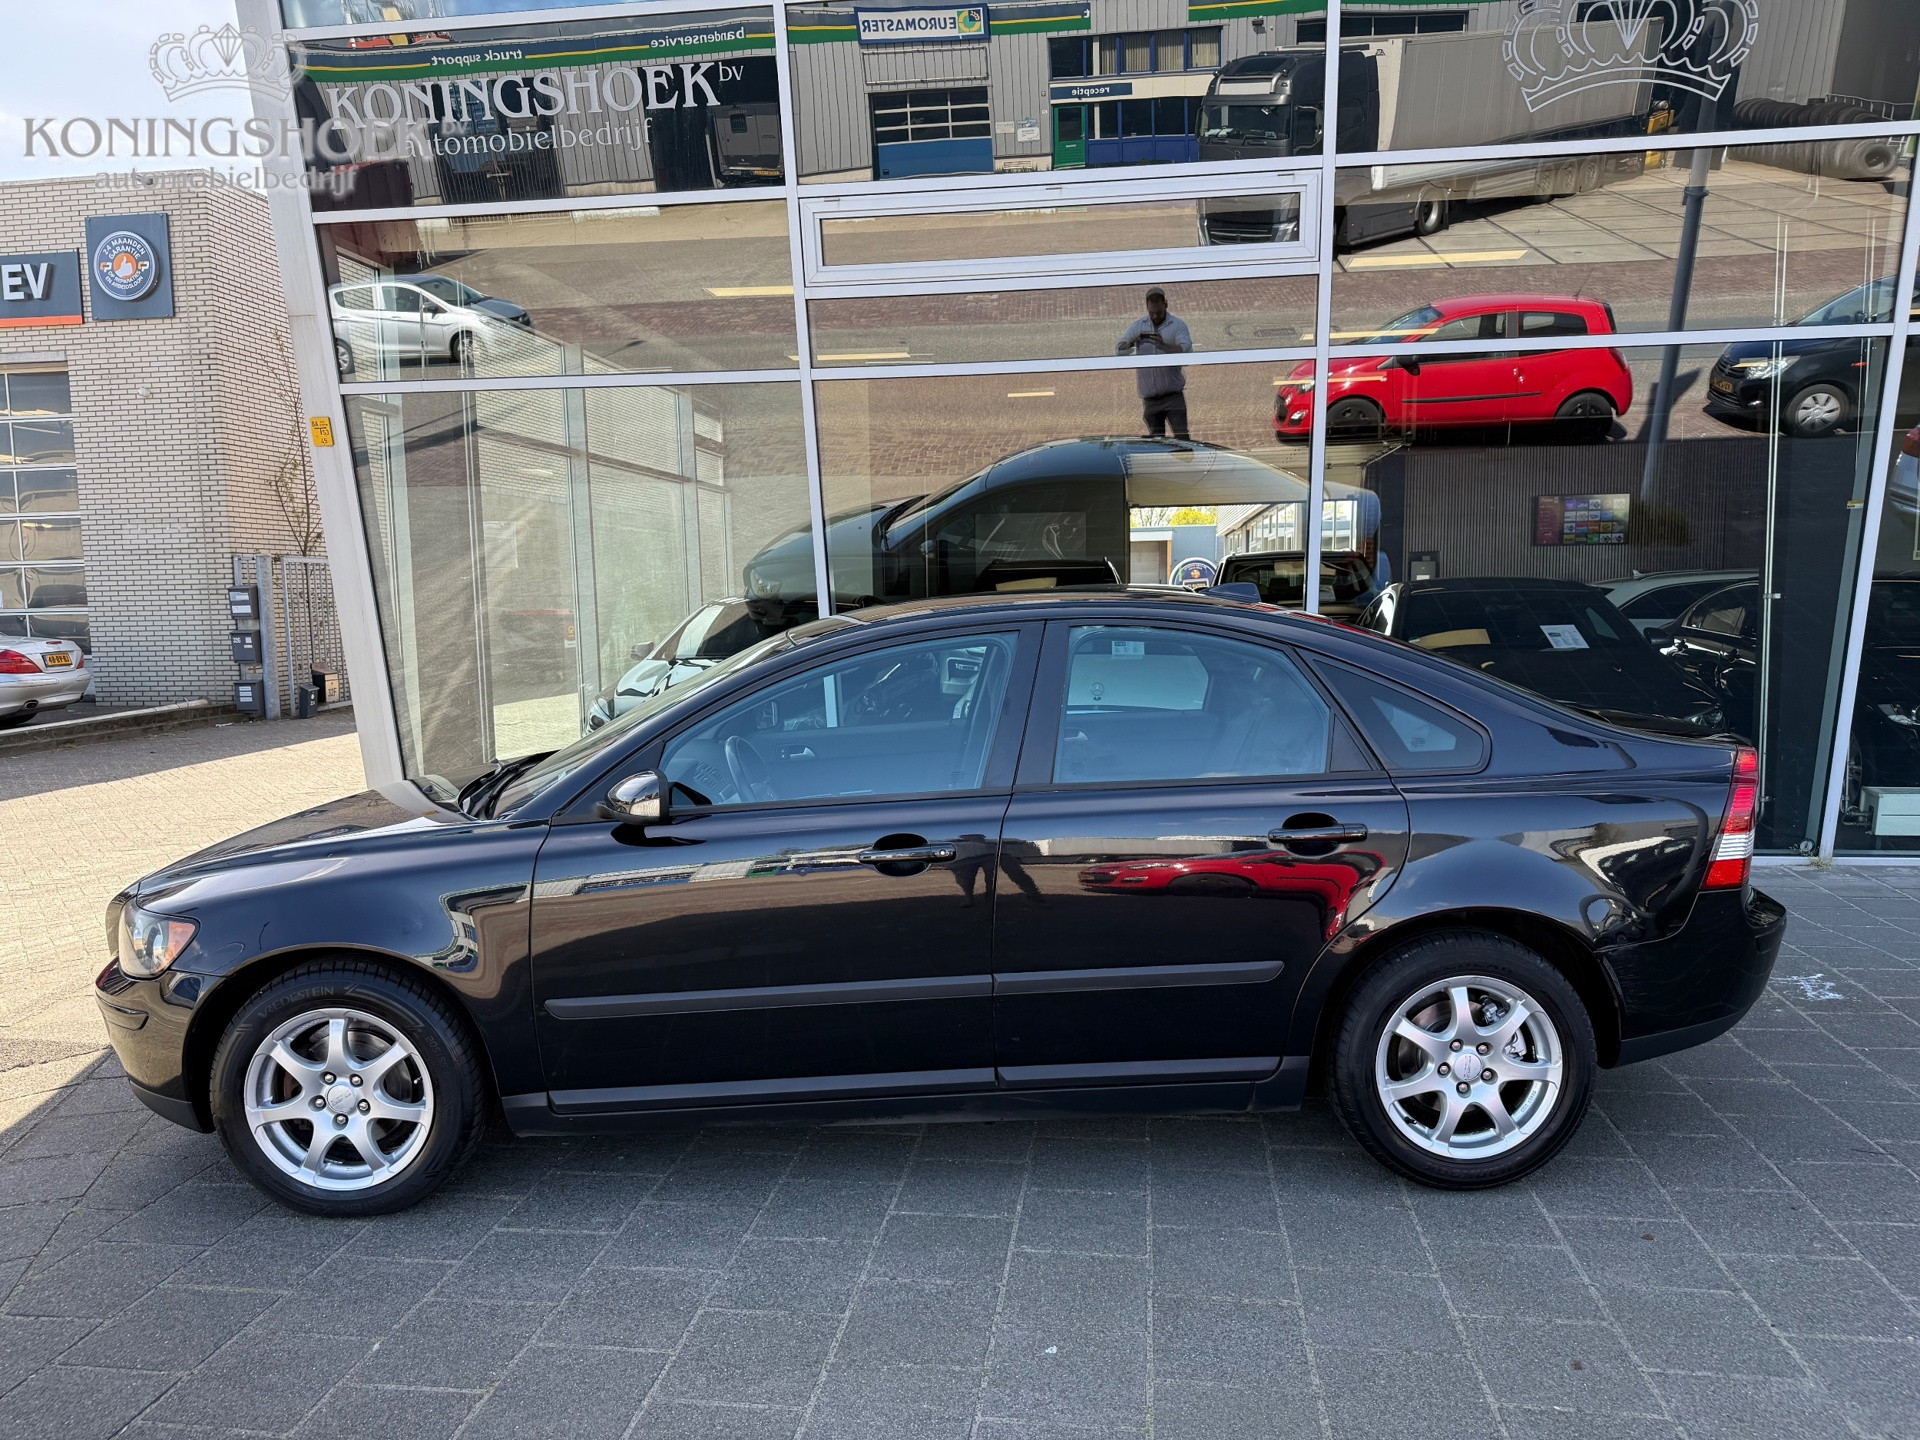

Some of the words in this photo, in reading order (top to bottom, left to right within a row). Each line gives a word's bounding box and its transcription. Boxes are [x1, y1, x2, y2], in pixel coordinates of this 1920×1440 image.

[326, 61, 721, 130] KONINGSHOEK
[718, 61, 744, 81] bv
[103, 244, 112, 255] 24
[111, 237, 146, 255] MAANDEN
[108, 245, 141, 260] GARANTIE
